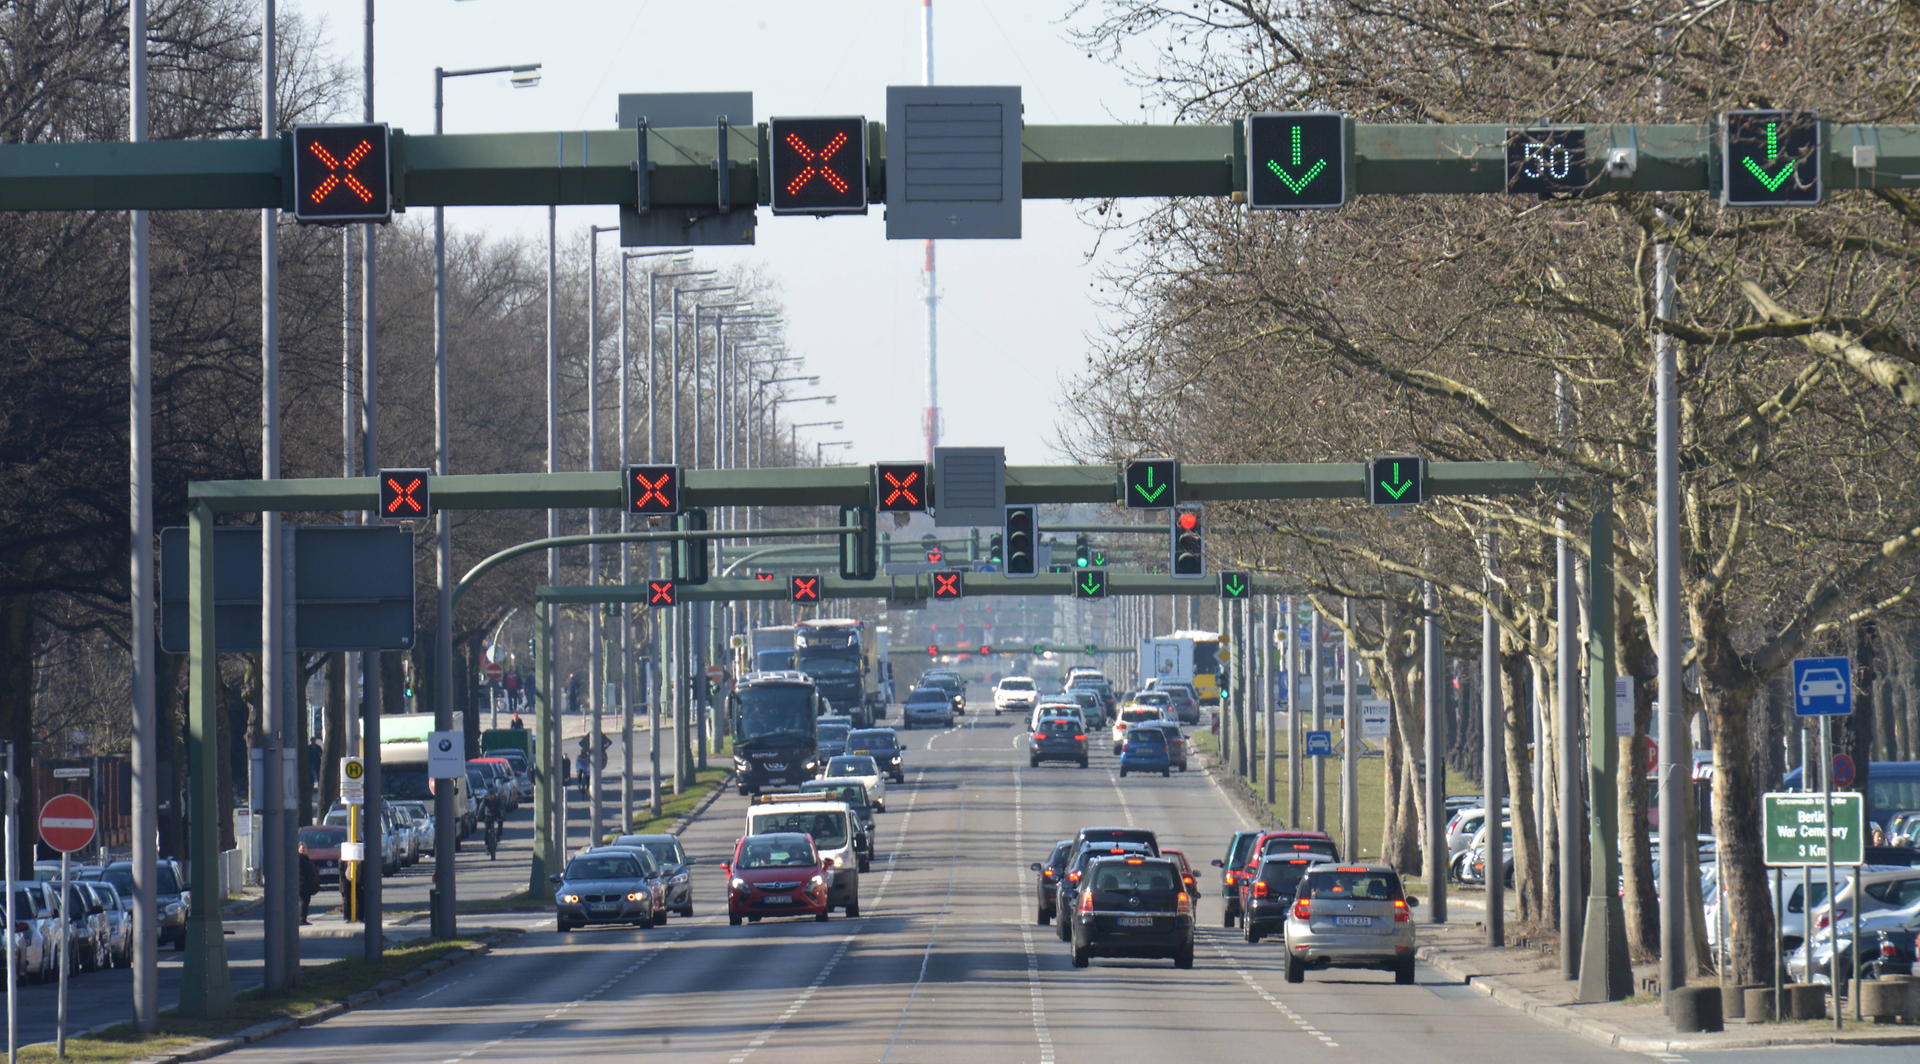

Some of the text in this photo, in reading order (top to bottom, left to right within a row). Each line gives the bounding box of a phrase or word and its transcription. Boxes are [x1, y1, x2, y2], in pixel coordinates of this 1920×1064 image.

[1525, 142, 1569, 178] 50
[1777, 825, 1797, 838] War
[1798, 844, 1806, 857] 3
